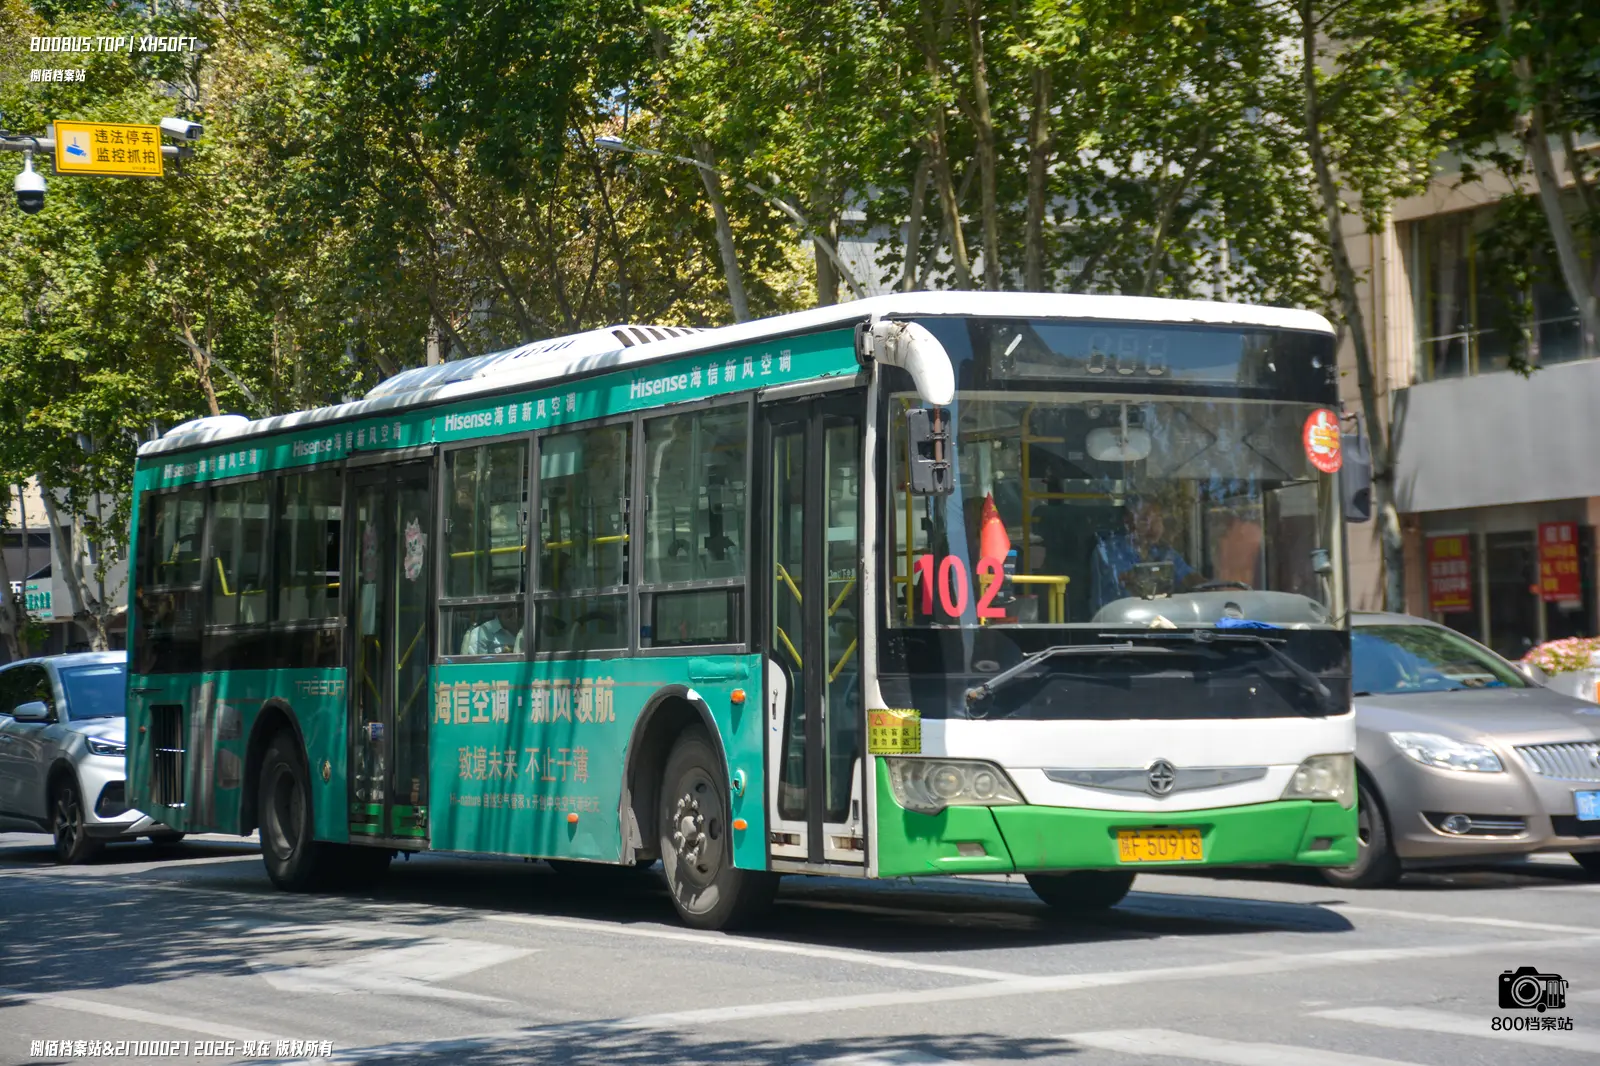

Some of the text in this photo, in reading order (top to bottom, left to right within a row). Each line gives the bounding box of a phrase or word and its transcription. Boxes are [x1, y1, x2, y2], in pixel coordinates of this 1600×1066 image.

[95, 129, 155, 146] 违法停车
[96, 147, 156, 164] 监控抓拍
[914, 554, 1007, 618] 102
